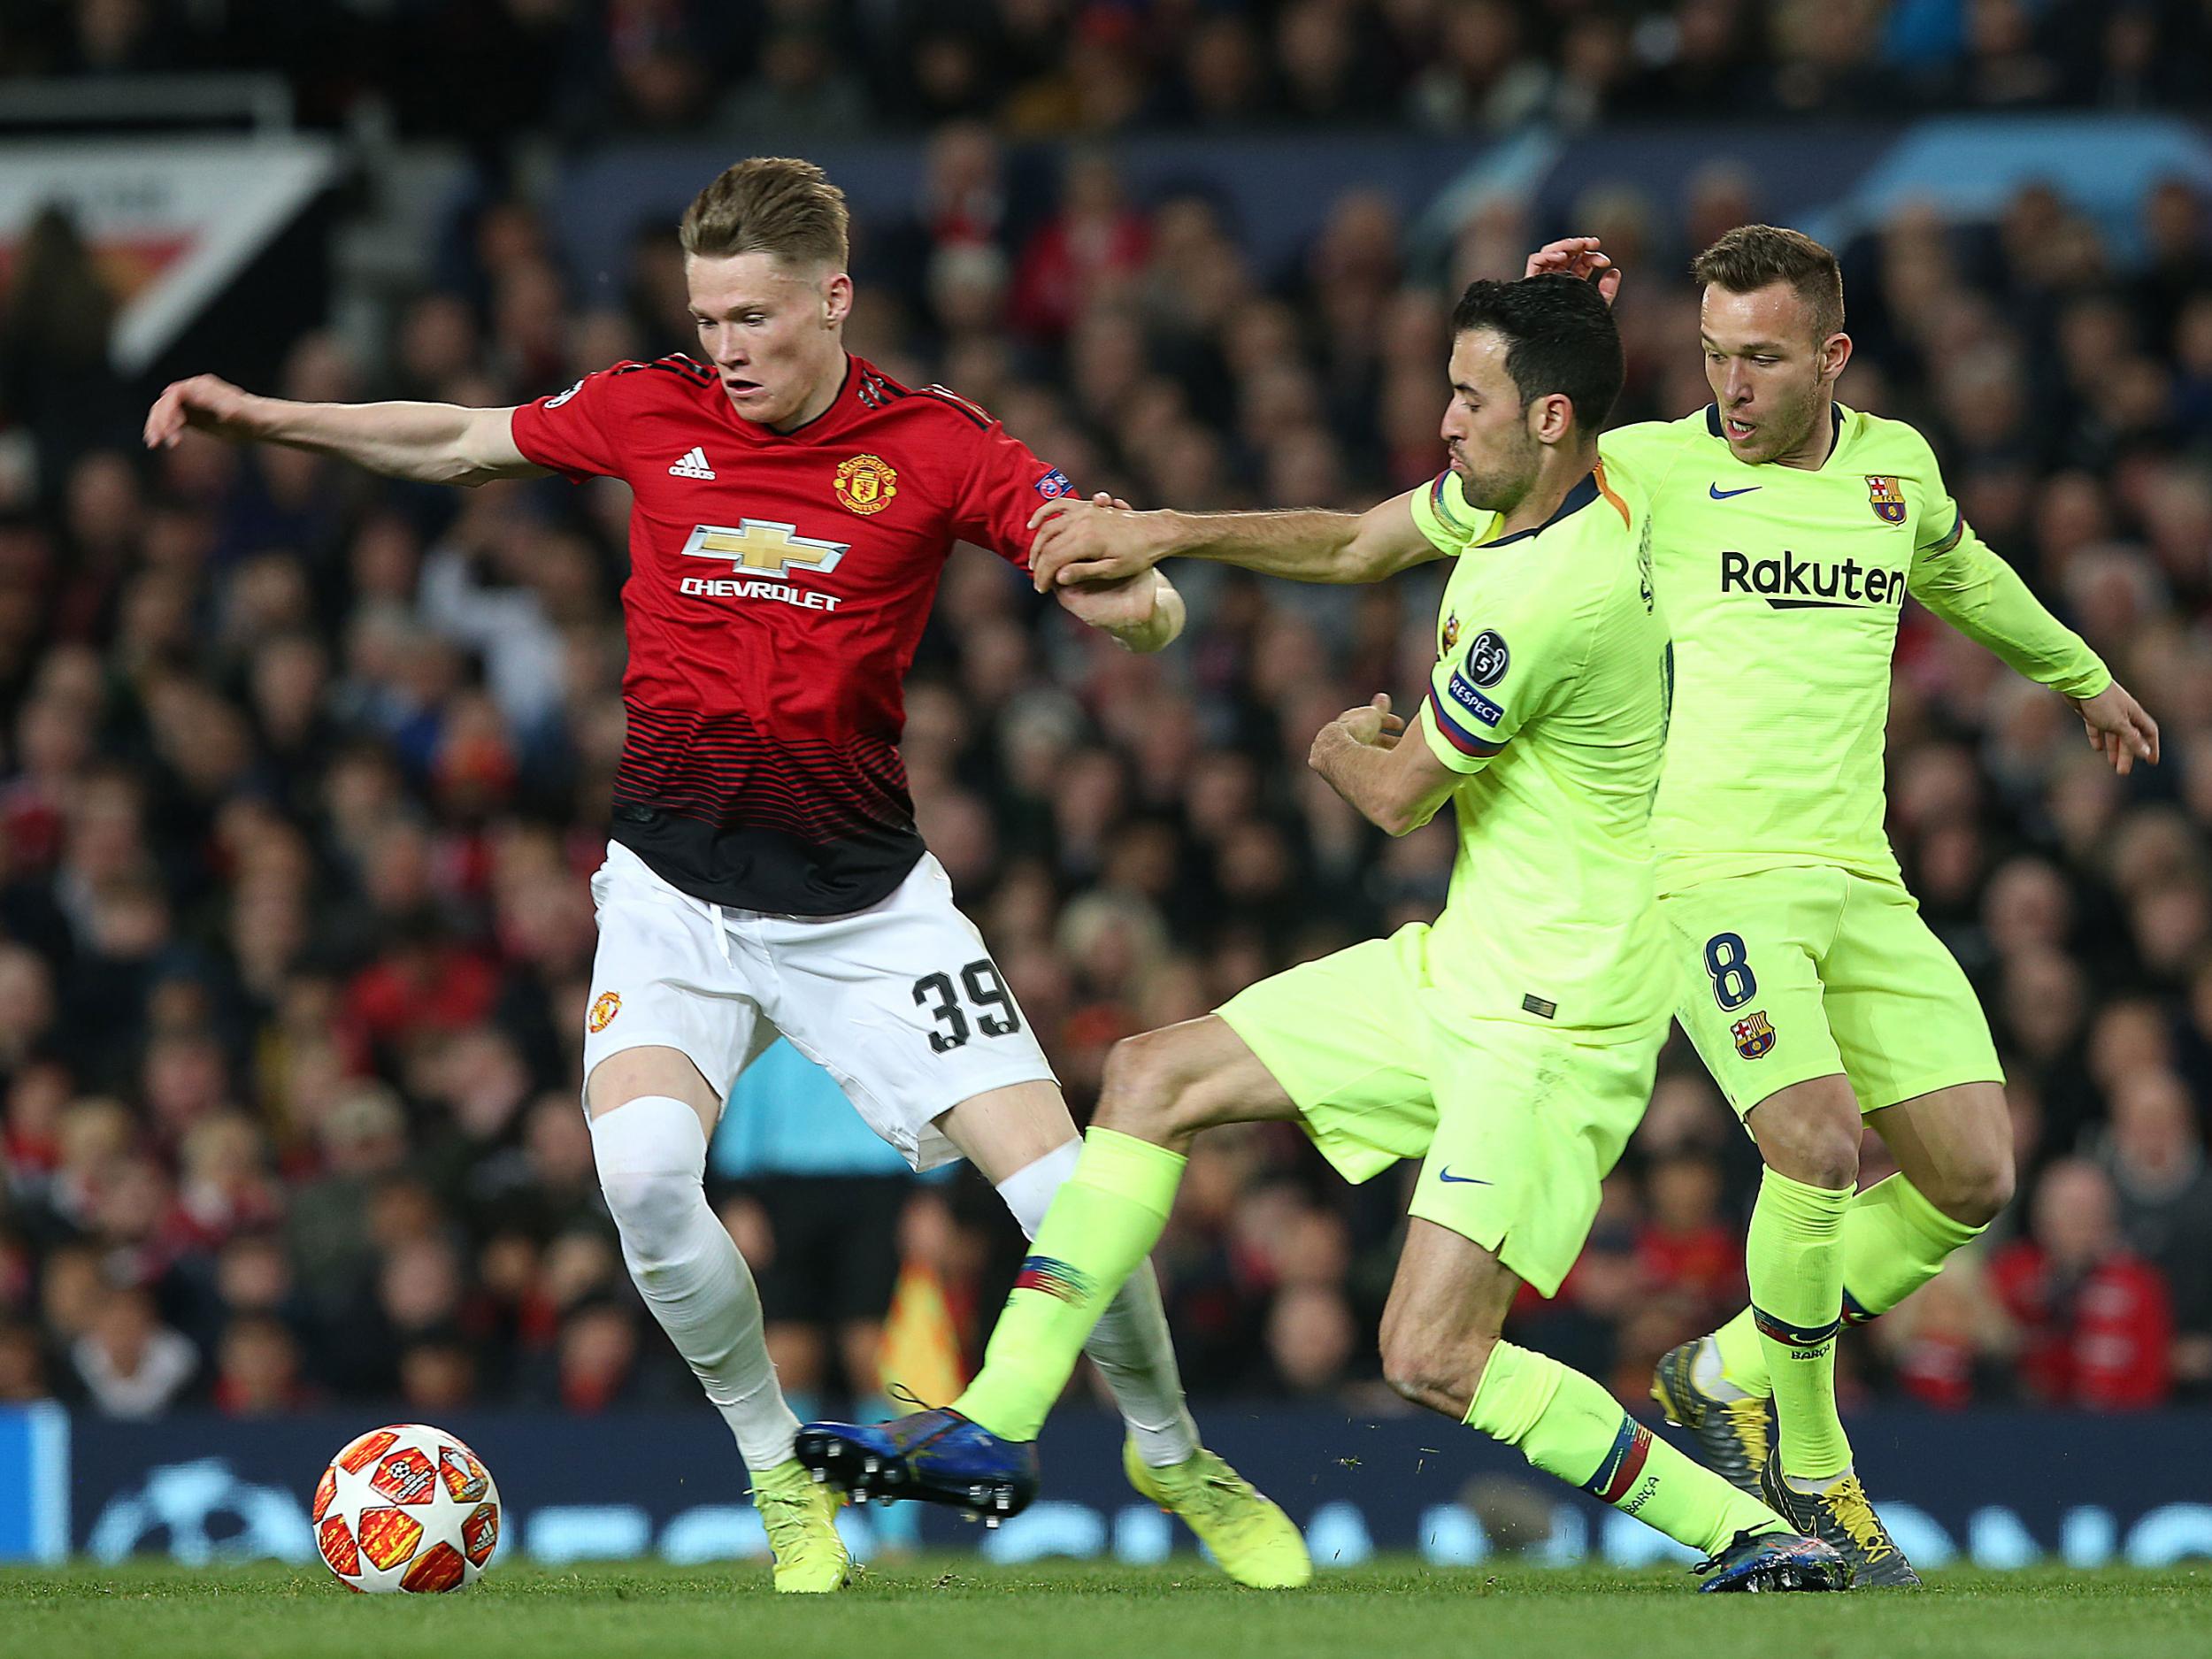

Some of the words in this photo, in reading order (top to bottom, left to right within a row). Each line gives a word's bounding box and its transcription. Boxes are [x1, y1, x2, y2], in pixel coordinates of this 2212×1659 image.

[668, 465, 717, 480] adidas
[680, 577, 841, 612] CHEVROLET
[1721, 550, 1906, 605] Rakuten
[1476, 657, 1492, 672] 5
[1450, 678, 1502, 721] RESPECT
[1703, 932, 1757, 1012] 8
[911, 957, 1021, 1055] 39
[1621, 1477, 1660, 1514] BARÇA
